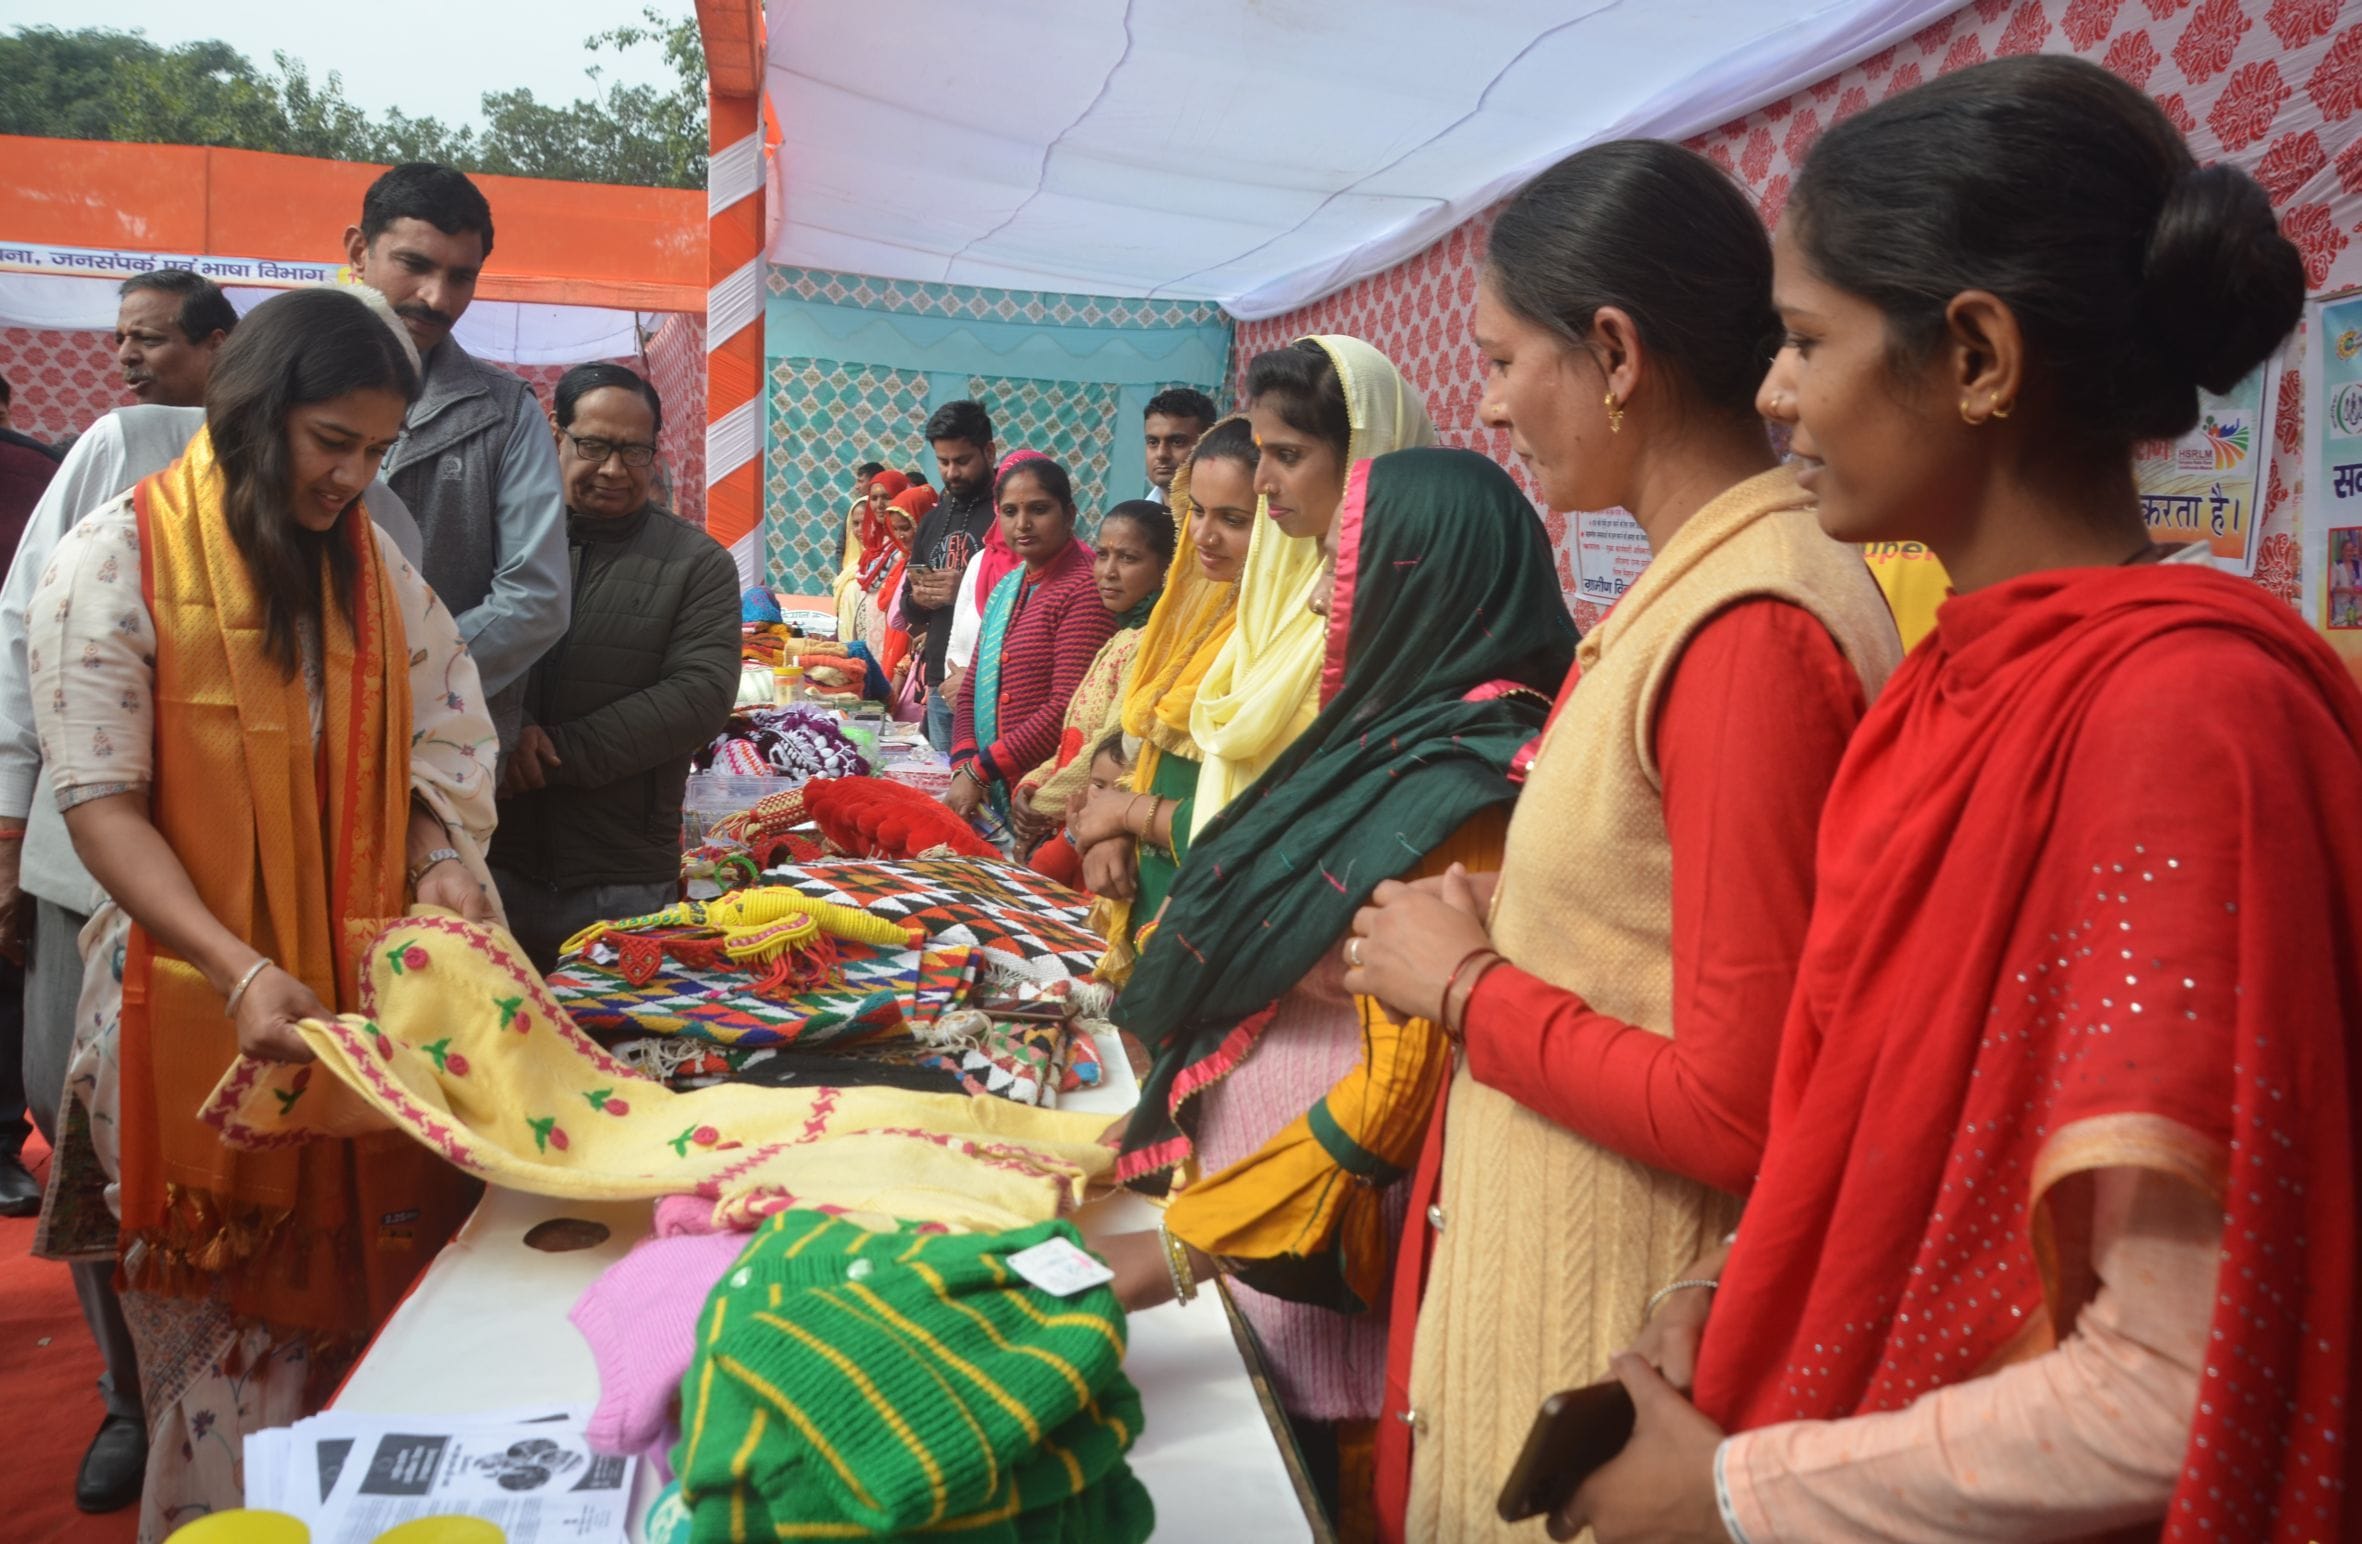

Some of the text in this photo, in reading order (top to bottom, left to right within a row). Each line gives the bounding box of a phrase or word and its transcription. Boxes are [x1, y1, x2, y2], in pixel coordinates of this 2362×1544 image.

[49, 252, 156, 271] जनसंपर्क
[202, 263, 250, 278] भाषा
[258, 261, 325, 281] विभाग
[2178, 449, 2213, 460] HSRLM
[2139, 494, 2203, 528] करता
